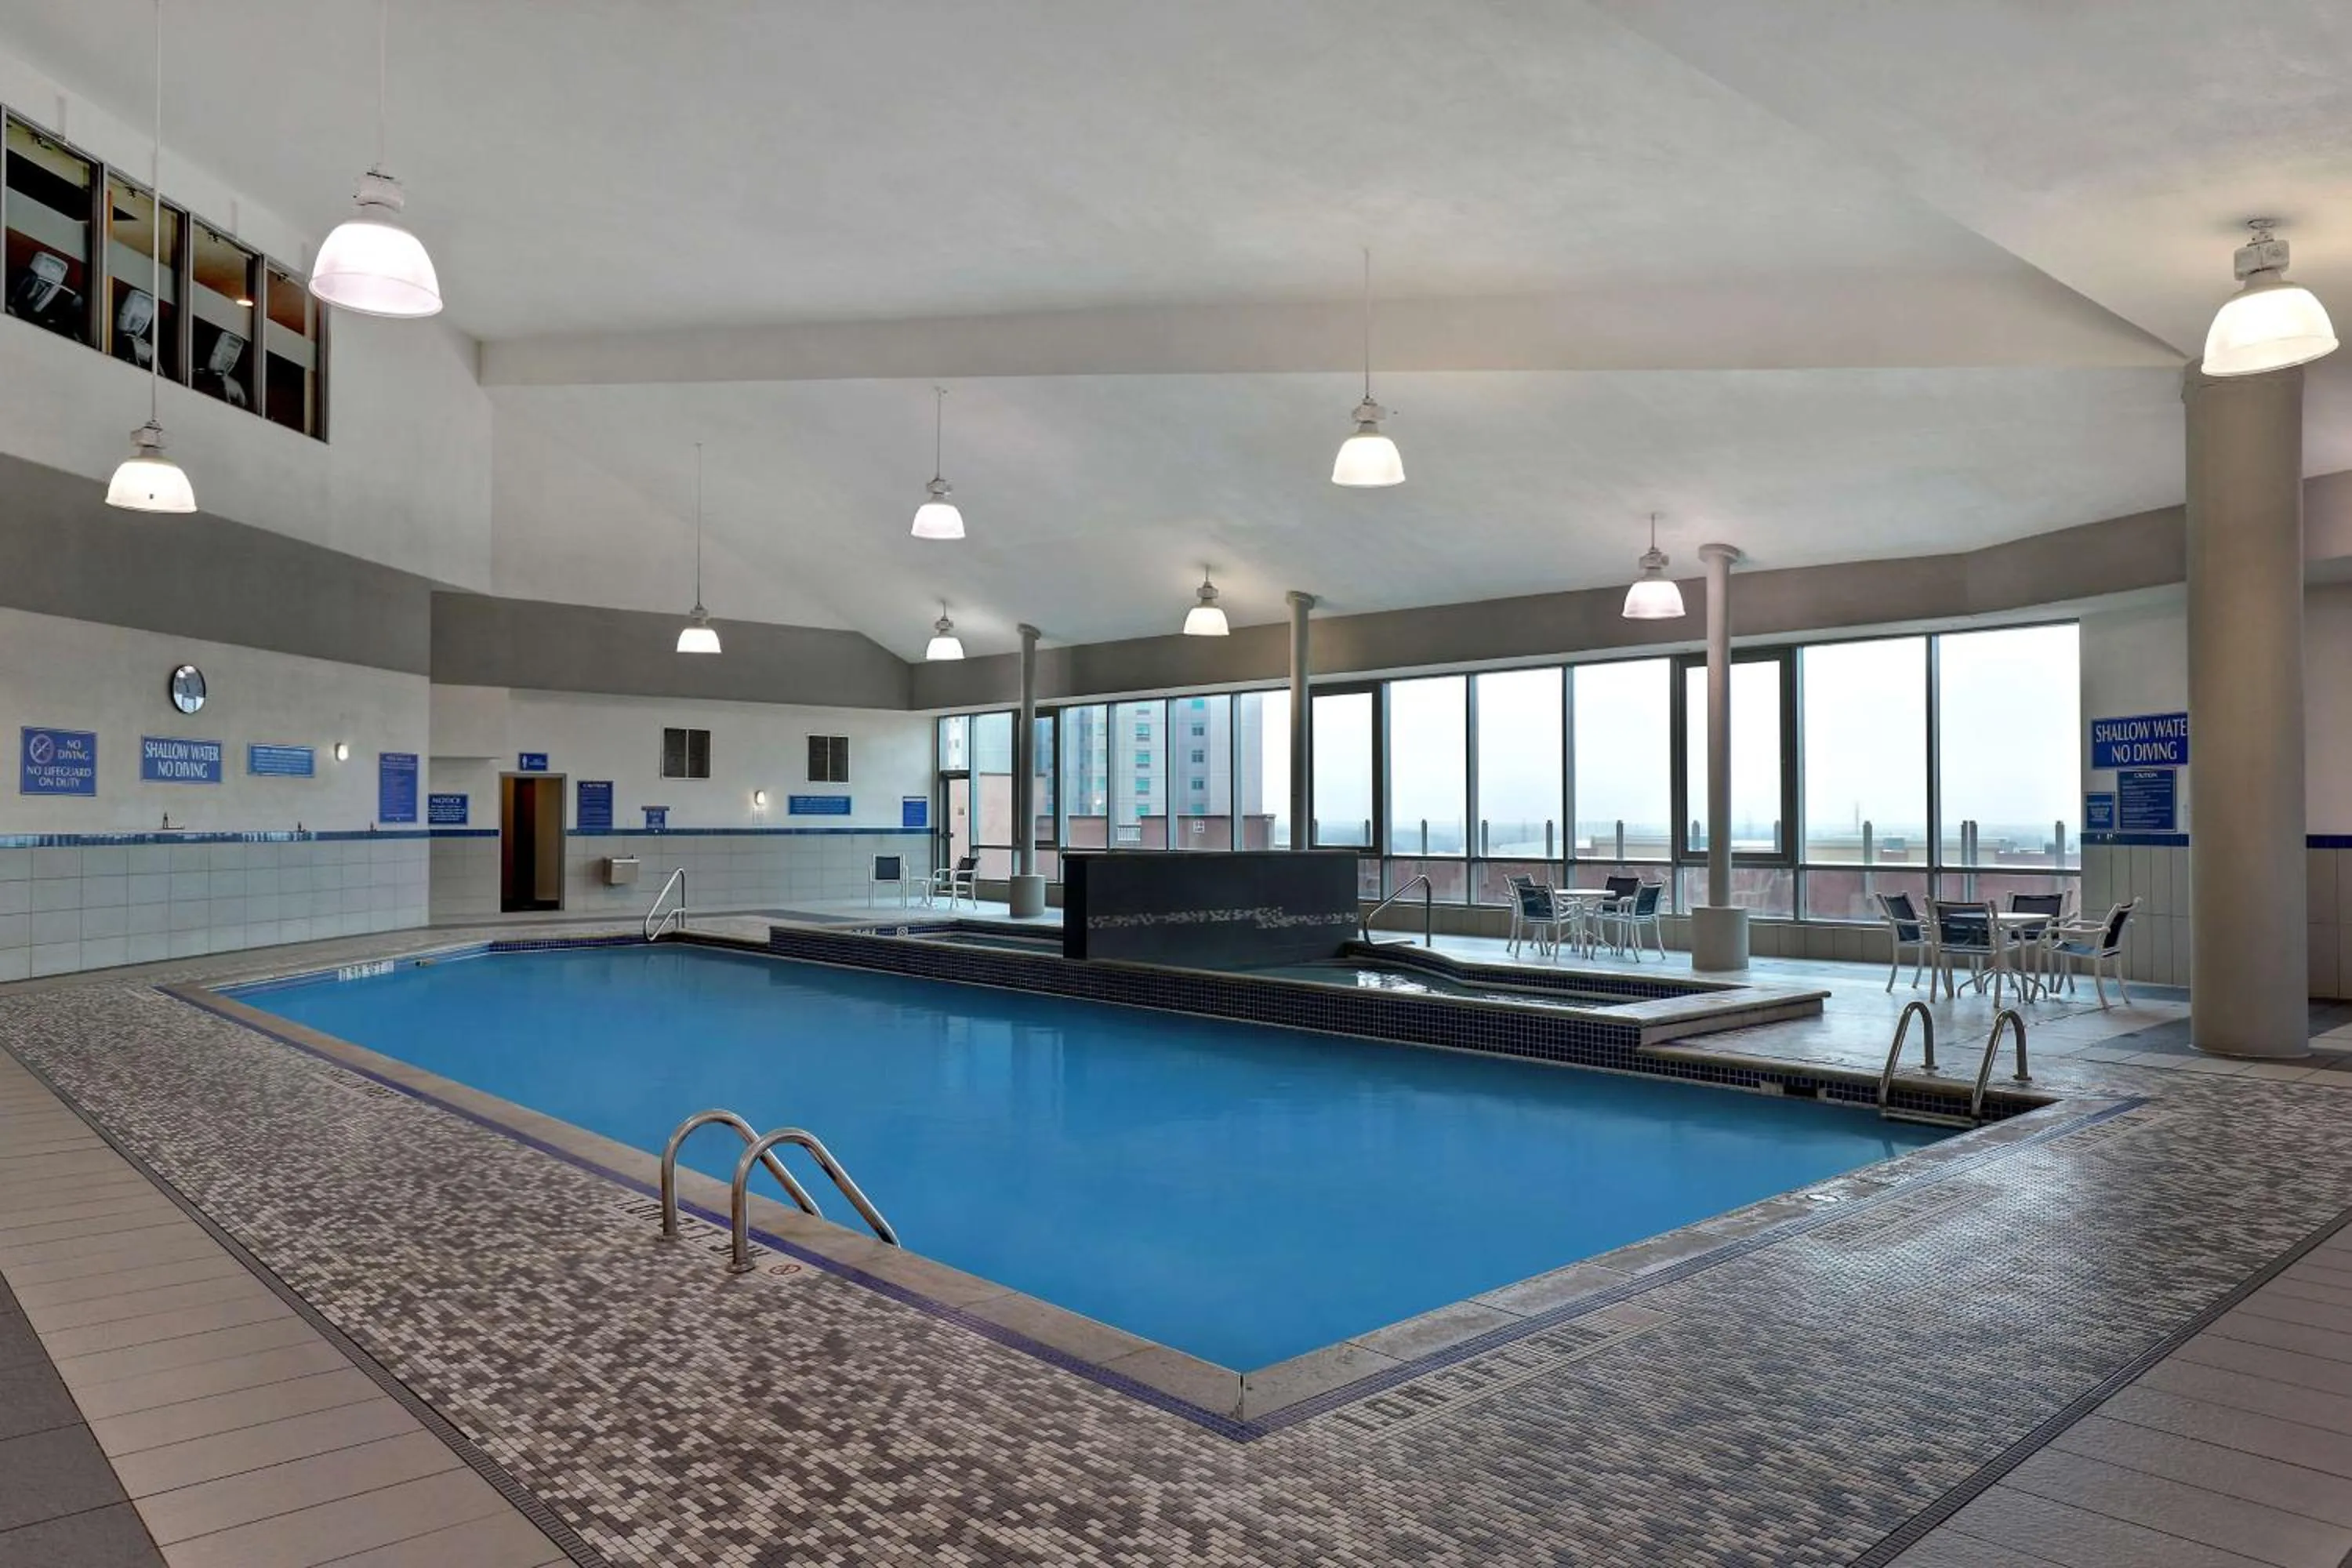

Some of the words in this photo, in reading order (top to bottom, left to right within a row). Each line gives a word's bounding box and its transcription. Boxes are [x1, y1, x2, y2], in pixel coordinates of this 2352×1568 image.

[2096, 722, 2151, 742] SHALLOW
[2153, 717, 2187, 738] WATE
[67, 739, 82, 750] NO
[146, 741, 188, 760] SHALLOW
[191, 744, 219, 761] WATER
[2111, 744, 2131, 763] NO
[2133, 741, 2177, 761] DIVING
[57, 750, 90, 760] DIVING
[27, 765, 42, 775] NO
[43, 766, 92, 777] LIFEGUARD
[158, 759, 173, 777] NO
[175, 761, 208, 779] DIVING
[38, 776, 54, 787] ON
[56, 778, 81, 788] DUTY
